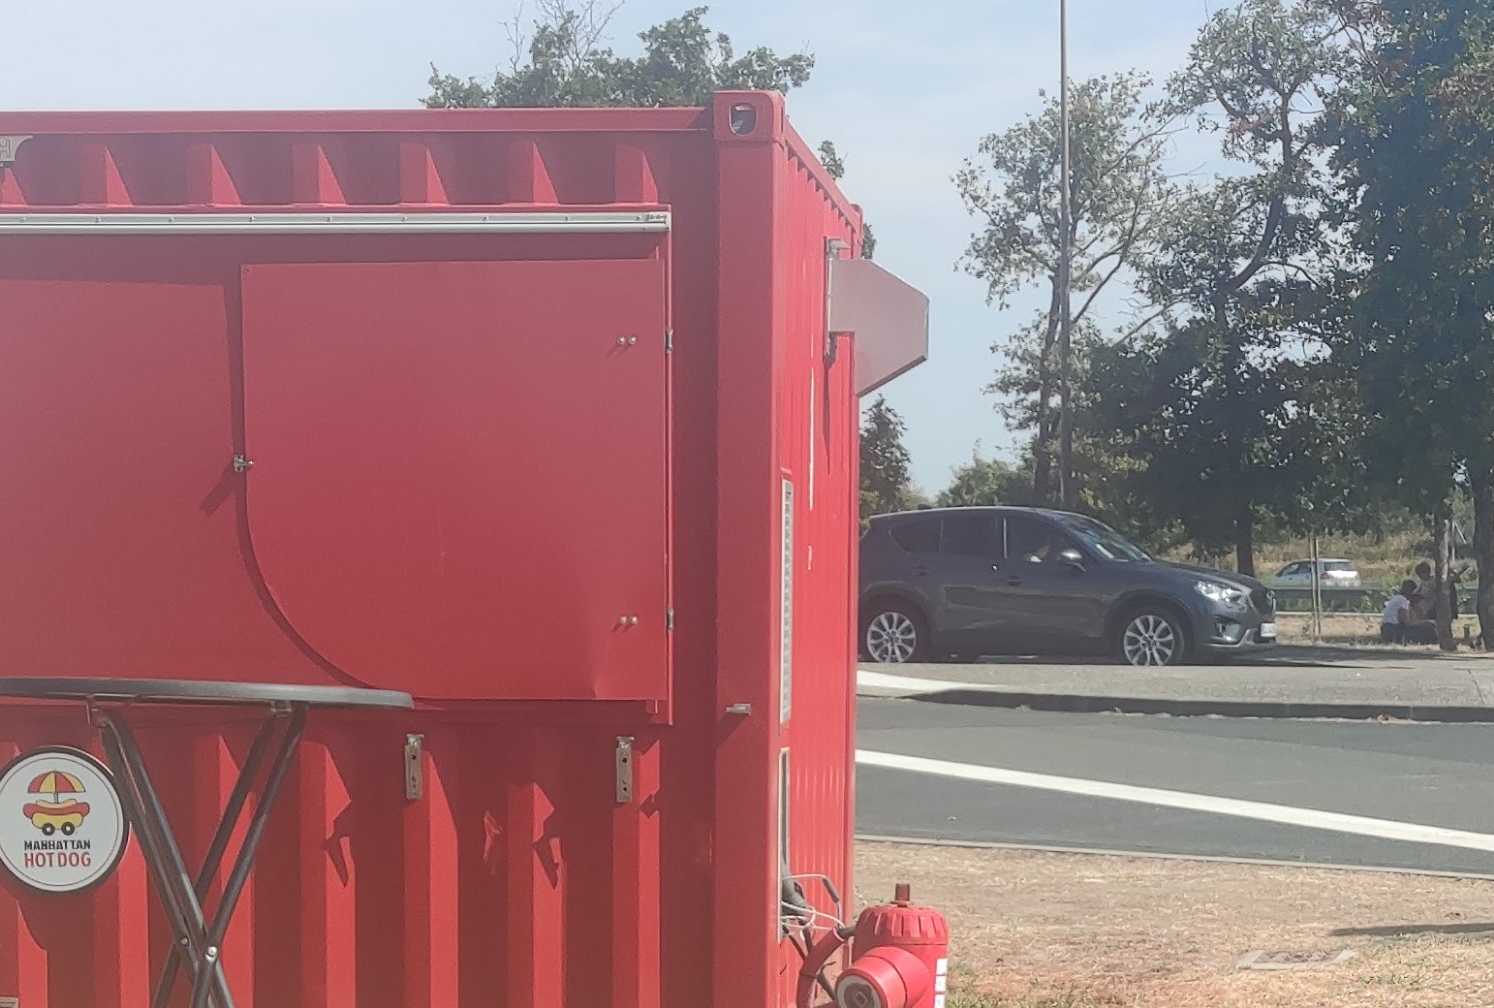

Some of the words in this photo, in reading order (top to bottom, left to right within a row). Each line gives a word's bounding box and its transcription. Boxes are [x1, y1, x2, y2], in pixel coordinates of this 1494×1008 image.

[24, 839, 91, 850] MANHATTAN
[24, 852, 54, 867] HOT
[57, 852, 91, 867] DOG
